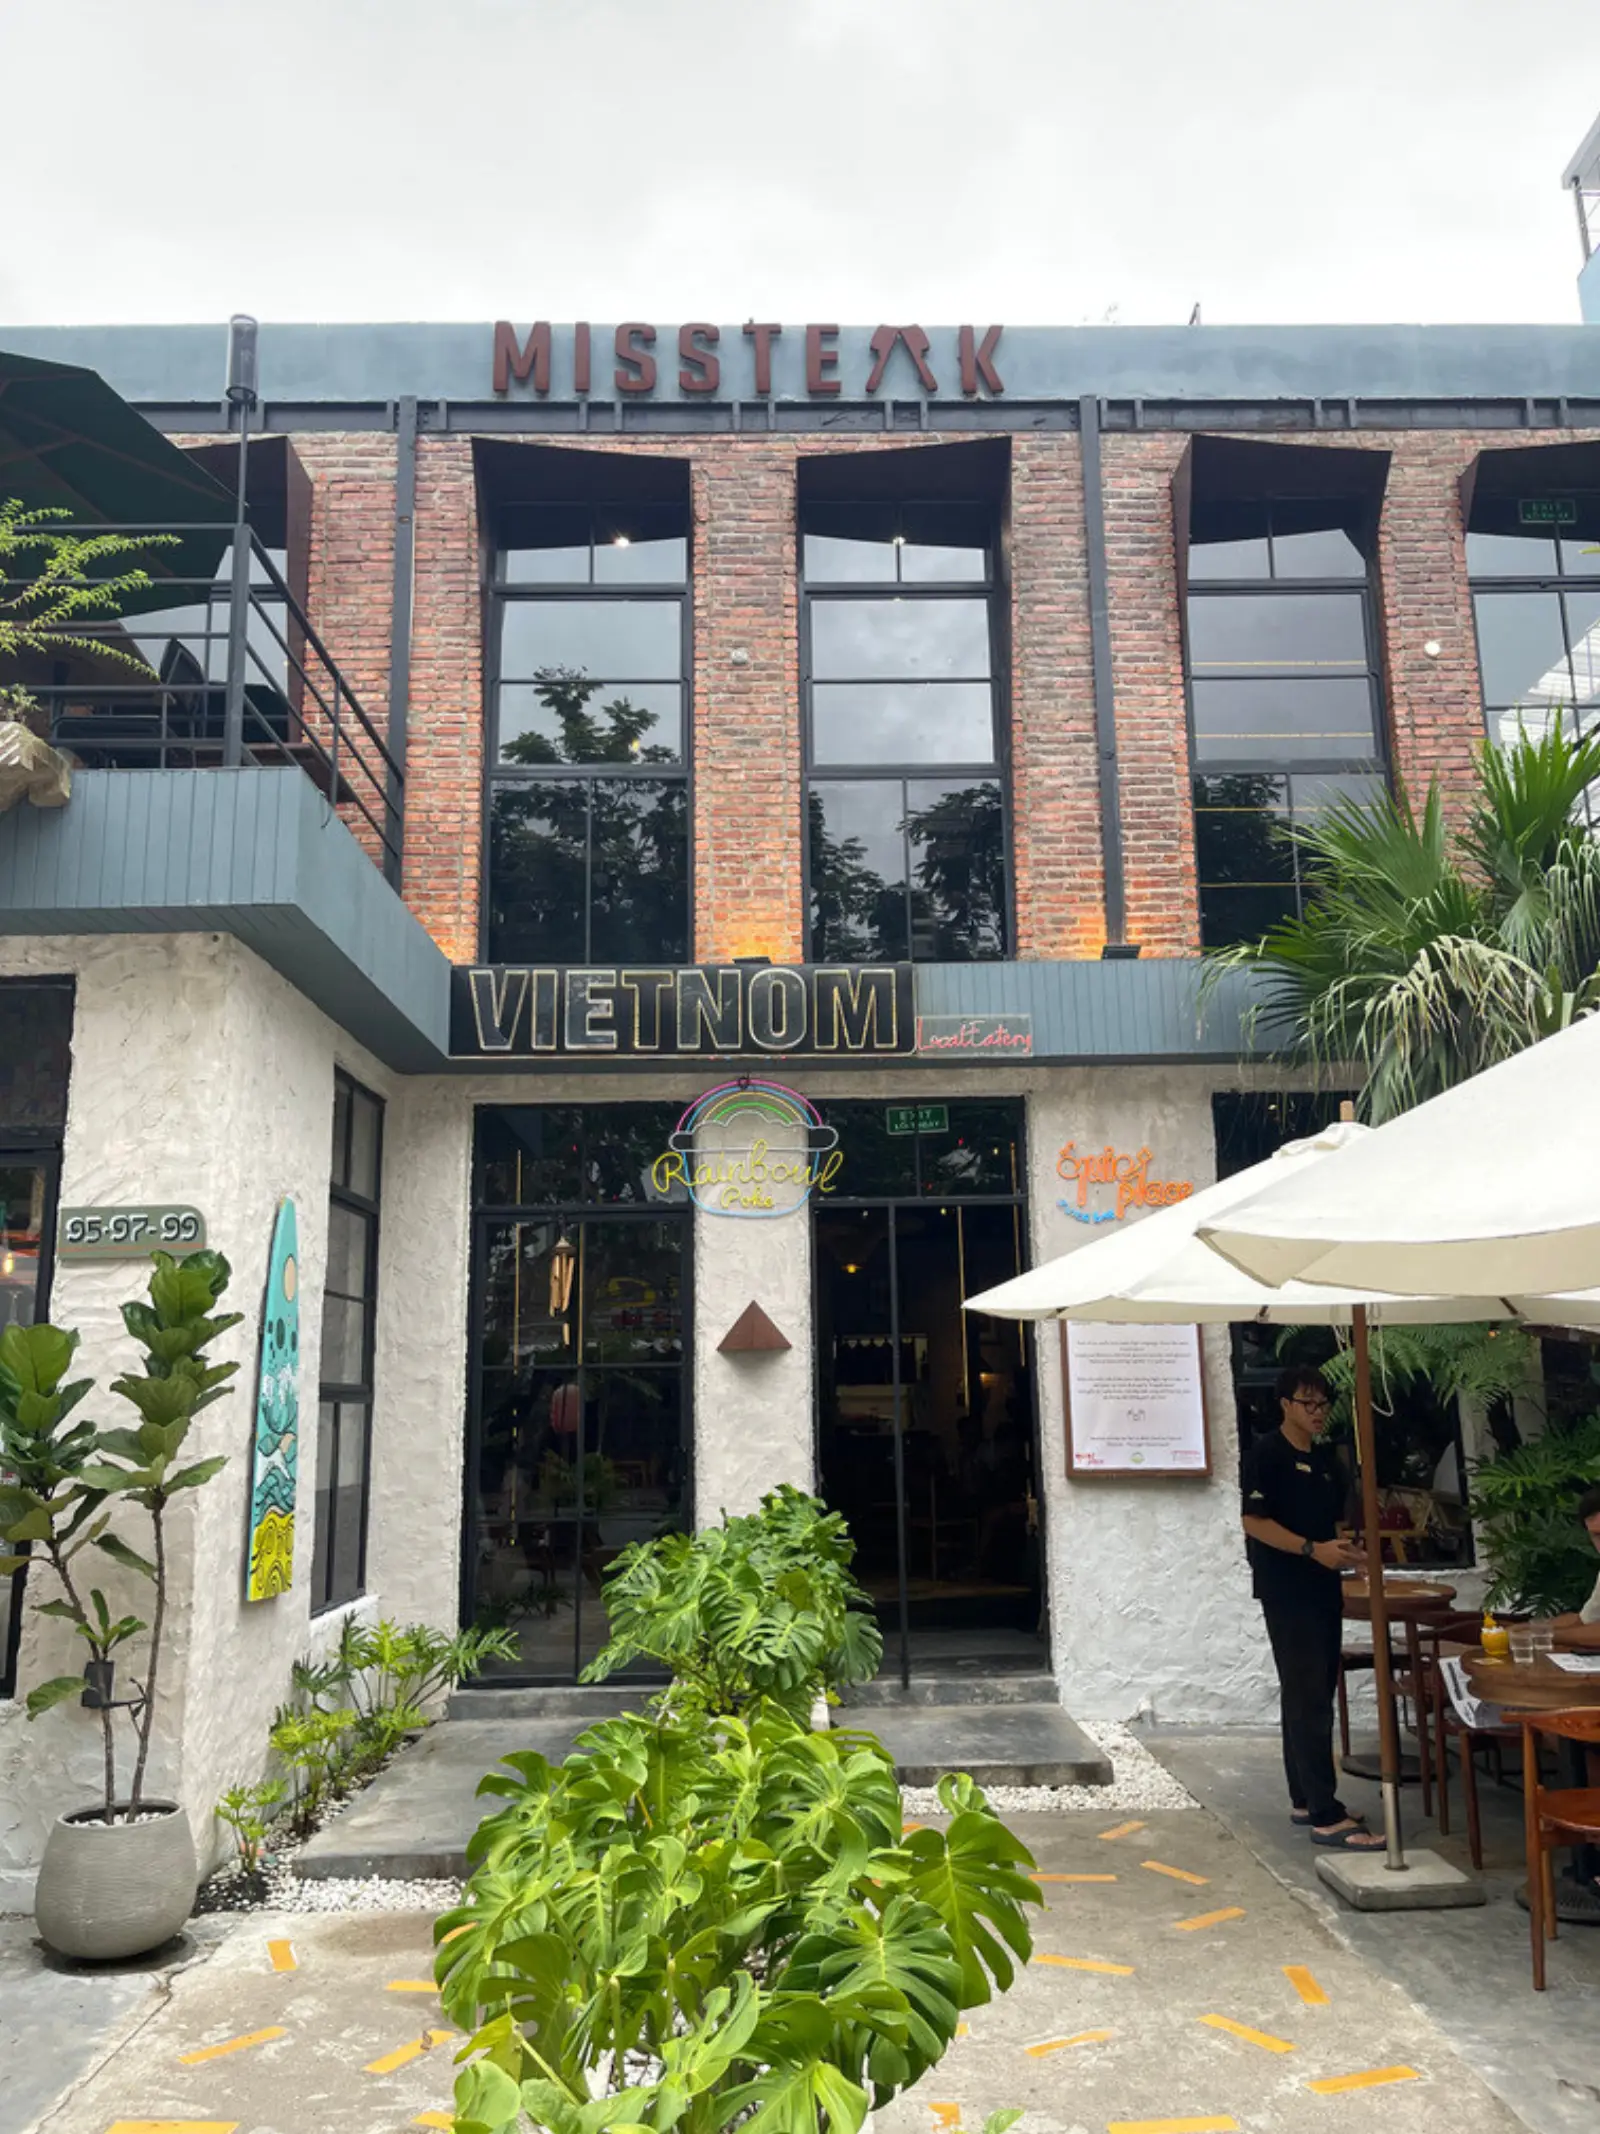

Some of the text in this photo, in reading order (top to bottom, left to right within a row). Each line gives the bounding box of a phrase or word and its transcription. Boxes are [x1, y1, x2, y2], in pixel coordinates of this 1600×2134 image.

[493, 320, 1004, 393] MISSTEAK
[469, 967, 898, 1050] VIETNOM
[652, 1139, 844, 1193] Rainbowl
